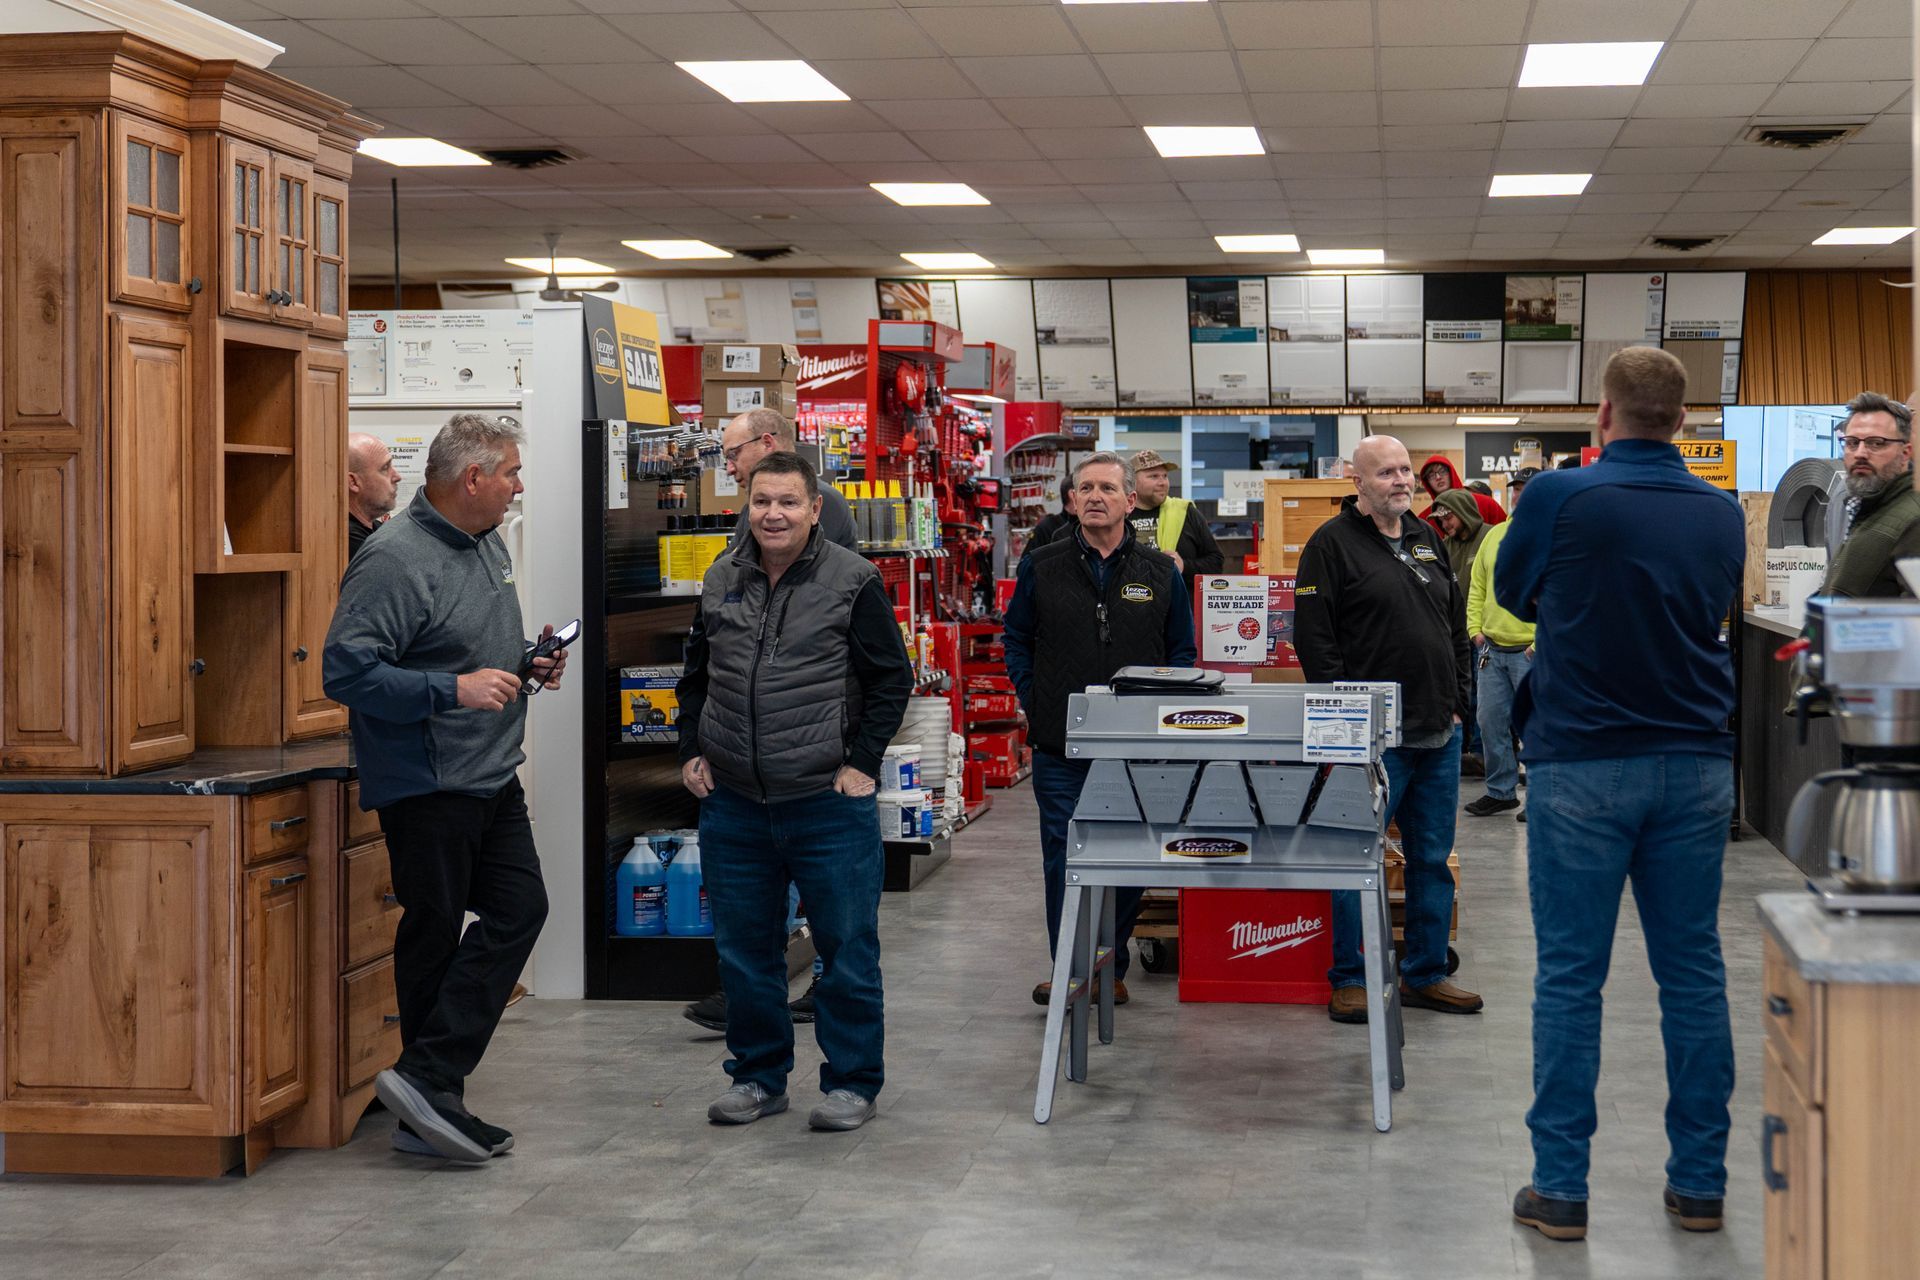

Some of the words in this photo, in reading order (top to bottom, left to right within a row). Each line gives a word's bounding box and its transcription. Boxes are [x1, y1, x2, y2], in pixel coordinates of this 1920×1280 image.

[624, 348, 661, 390] SALE
[1766, 561, 1798, 571] BestPLUS
[1207, 601, 1230, 609] SAW
[1232, 601, 1264, 609] BLADE
[631, 724, 644, 733] 50
[1175, 840, 1237, 848] Lezzer
[1226, 915, 1323, 950] Milwaukee
